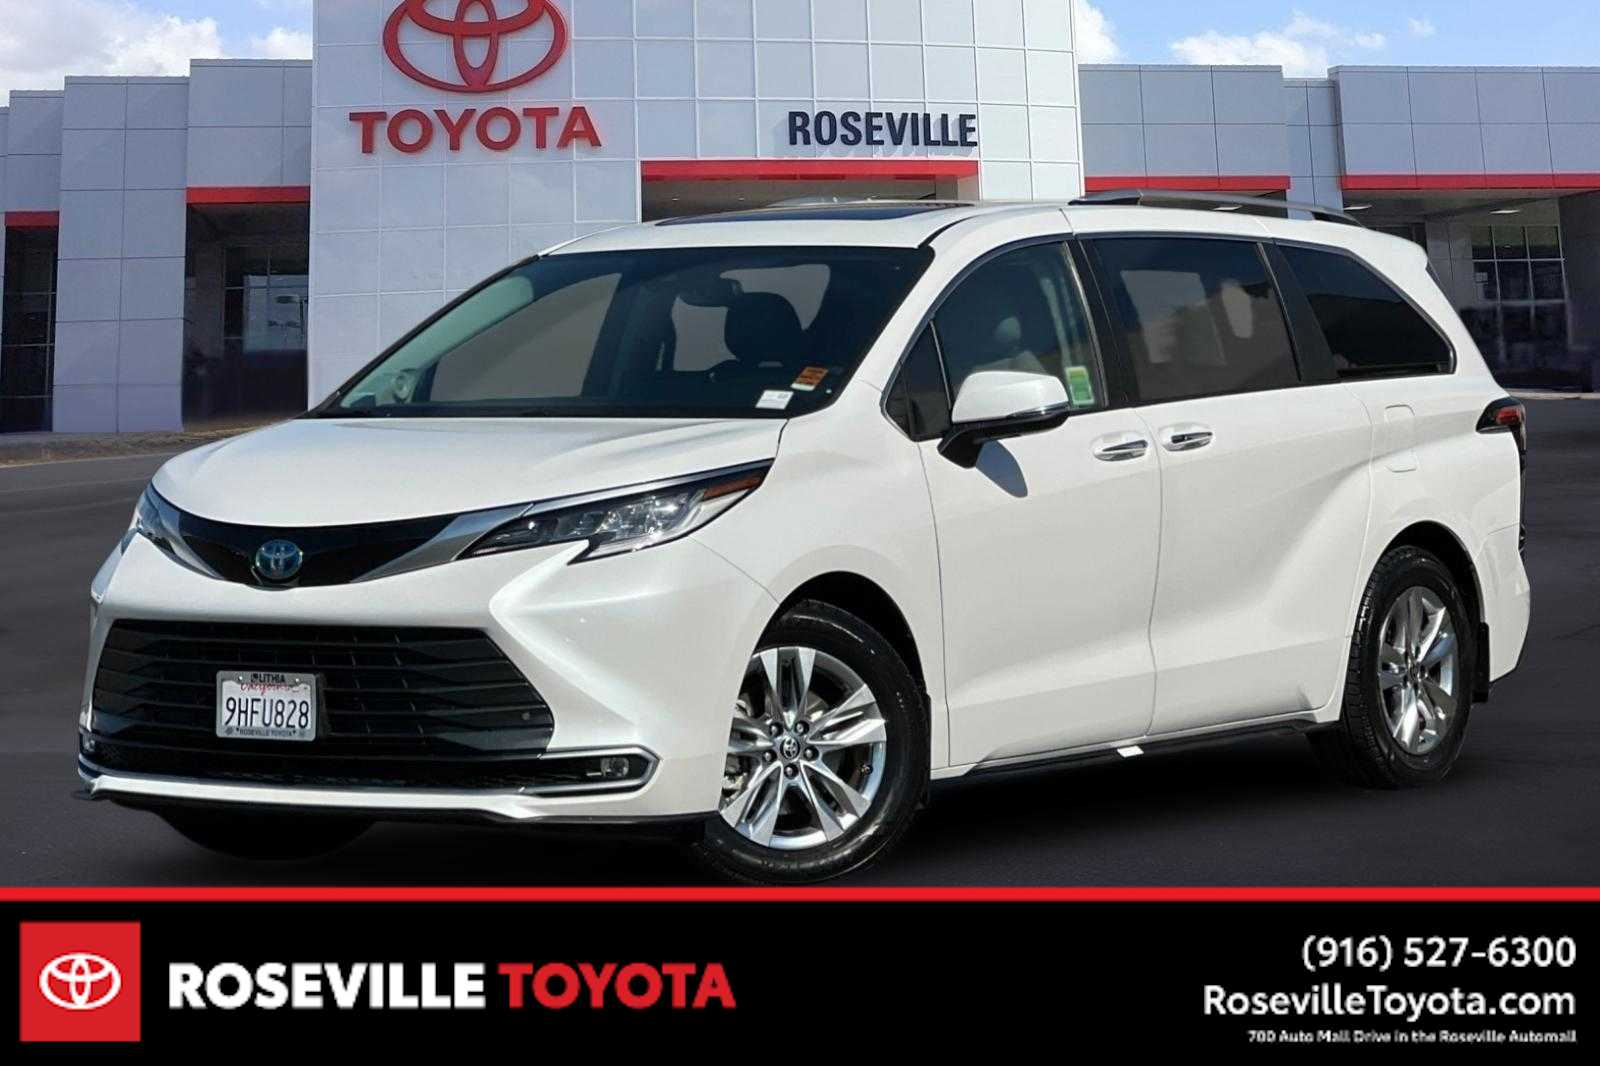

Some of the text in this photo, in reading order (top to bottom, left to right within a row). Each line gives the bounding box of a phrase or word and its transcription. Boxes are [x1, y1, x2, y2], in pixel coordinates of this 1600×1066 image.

[349, 106, 603, 153] TOYOTA
[787, 110, 978, 147] ROSEVILLE
[225, 697, 309, 728] 9HFU828
